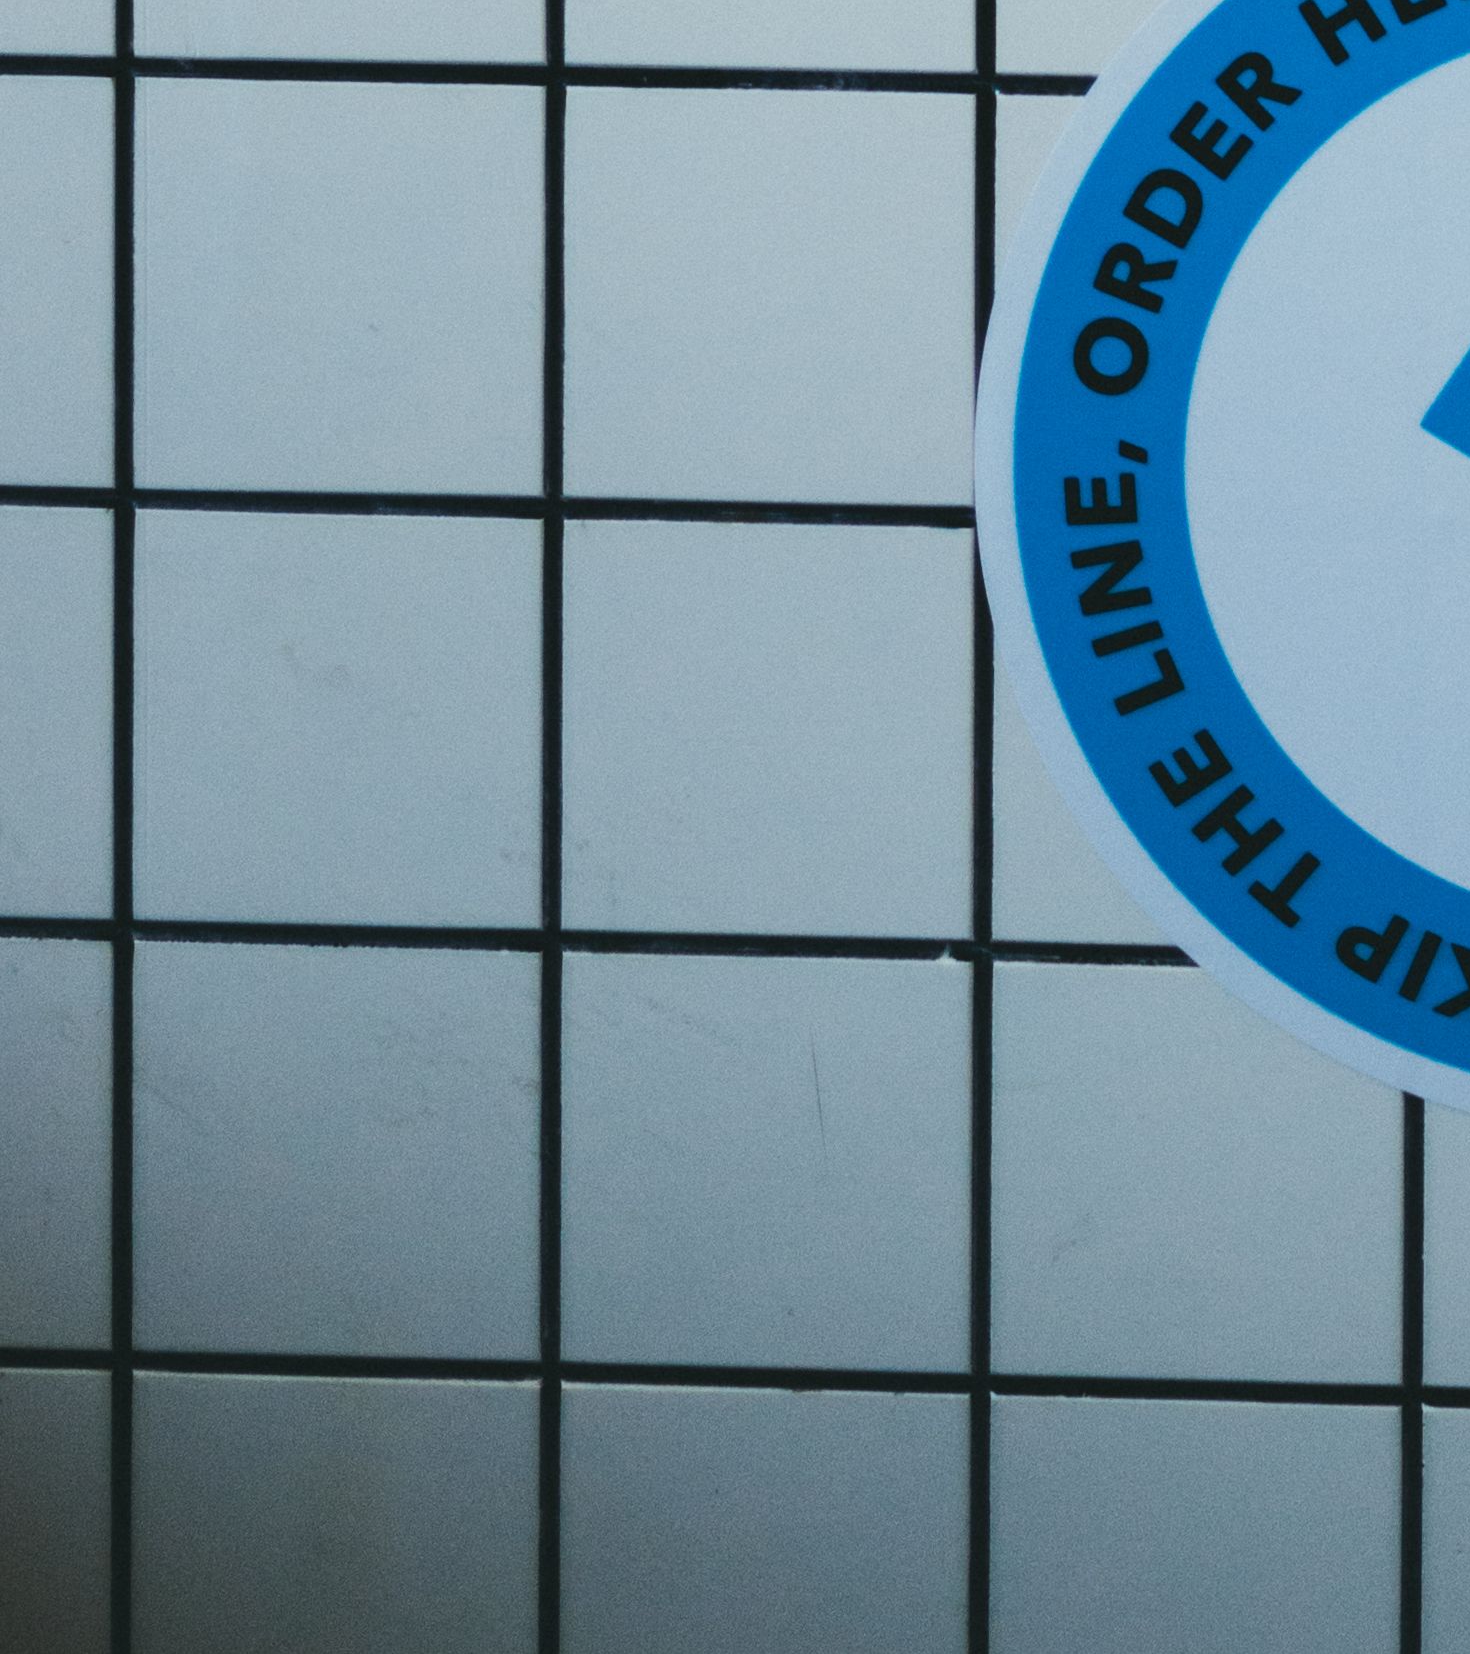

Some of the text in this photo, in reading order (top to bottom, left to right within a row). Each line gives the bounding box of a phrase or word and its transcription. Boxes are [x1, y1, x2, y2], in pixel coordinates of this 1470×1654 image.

[1072, 51, 1303, 397] ORDER
[1062, 439, 1186, 717] LINE,
[1147, 728, 1322, 929] THE
